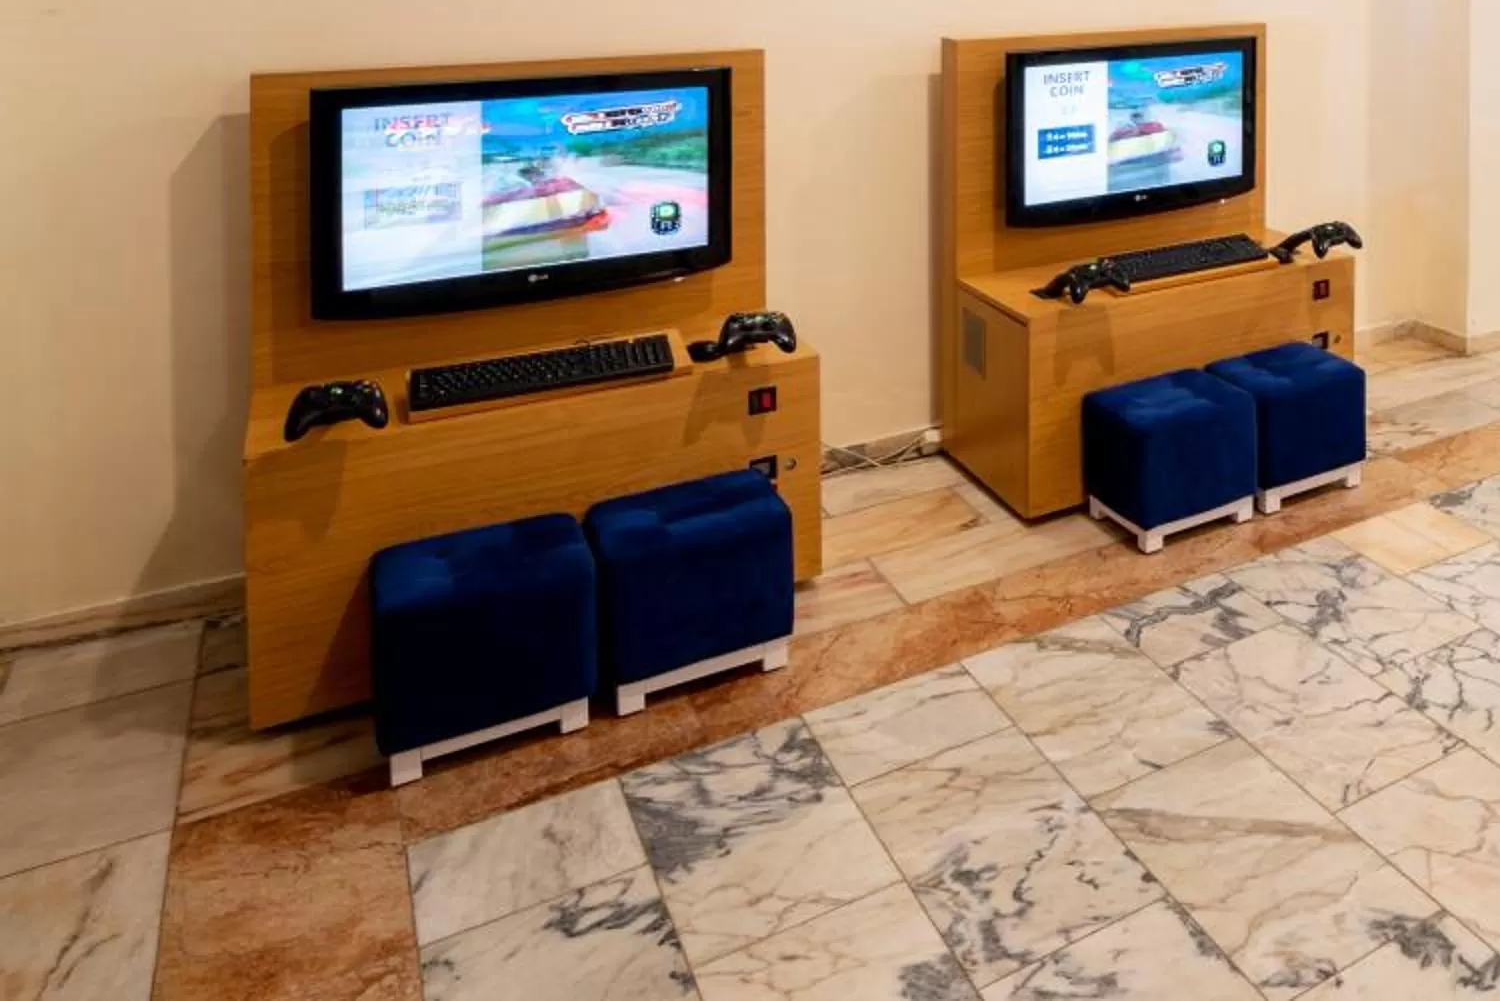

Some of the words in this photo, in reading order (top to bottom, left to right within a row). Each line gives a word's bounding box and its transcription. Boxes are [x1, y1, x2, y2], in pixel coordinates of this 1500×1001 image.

[1043, 70, 1091, 85] INSERT
[1049, 84, 1084, 98] COIN
[373, 112, 452, 132] INSERT
